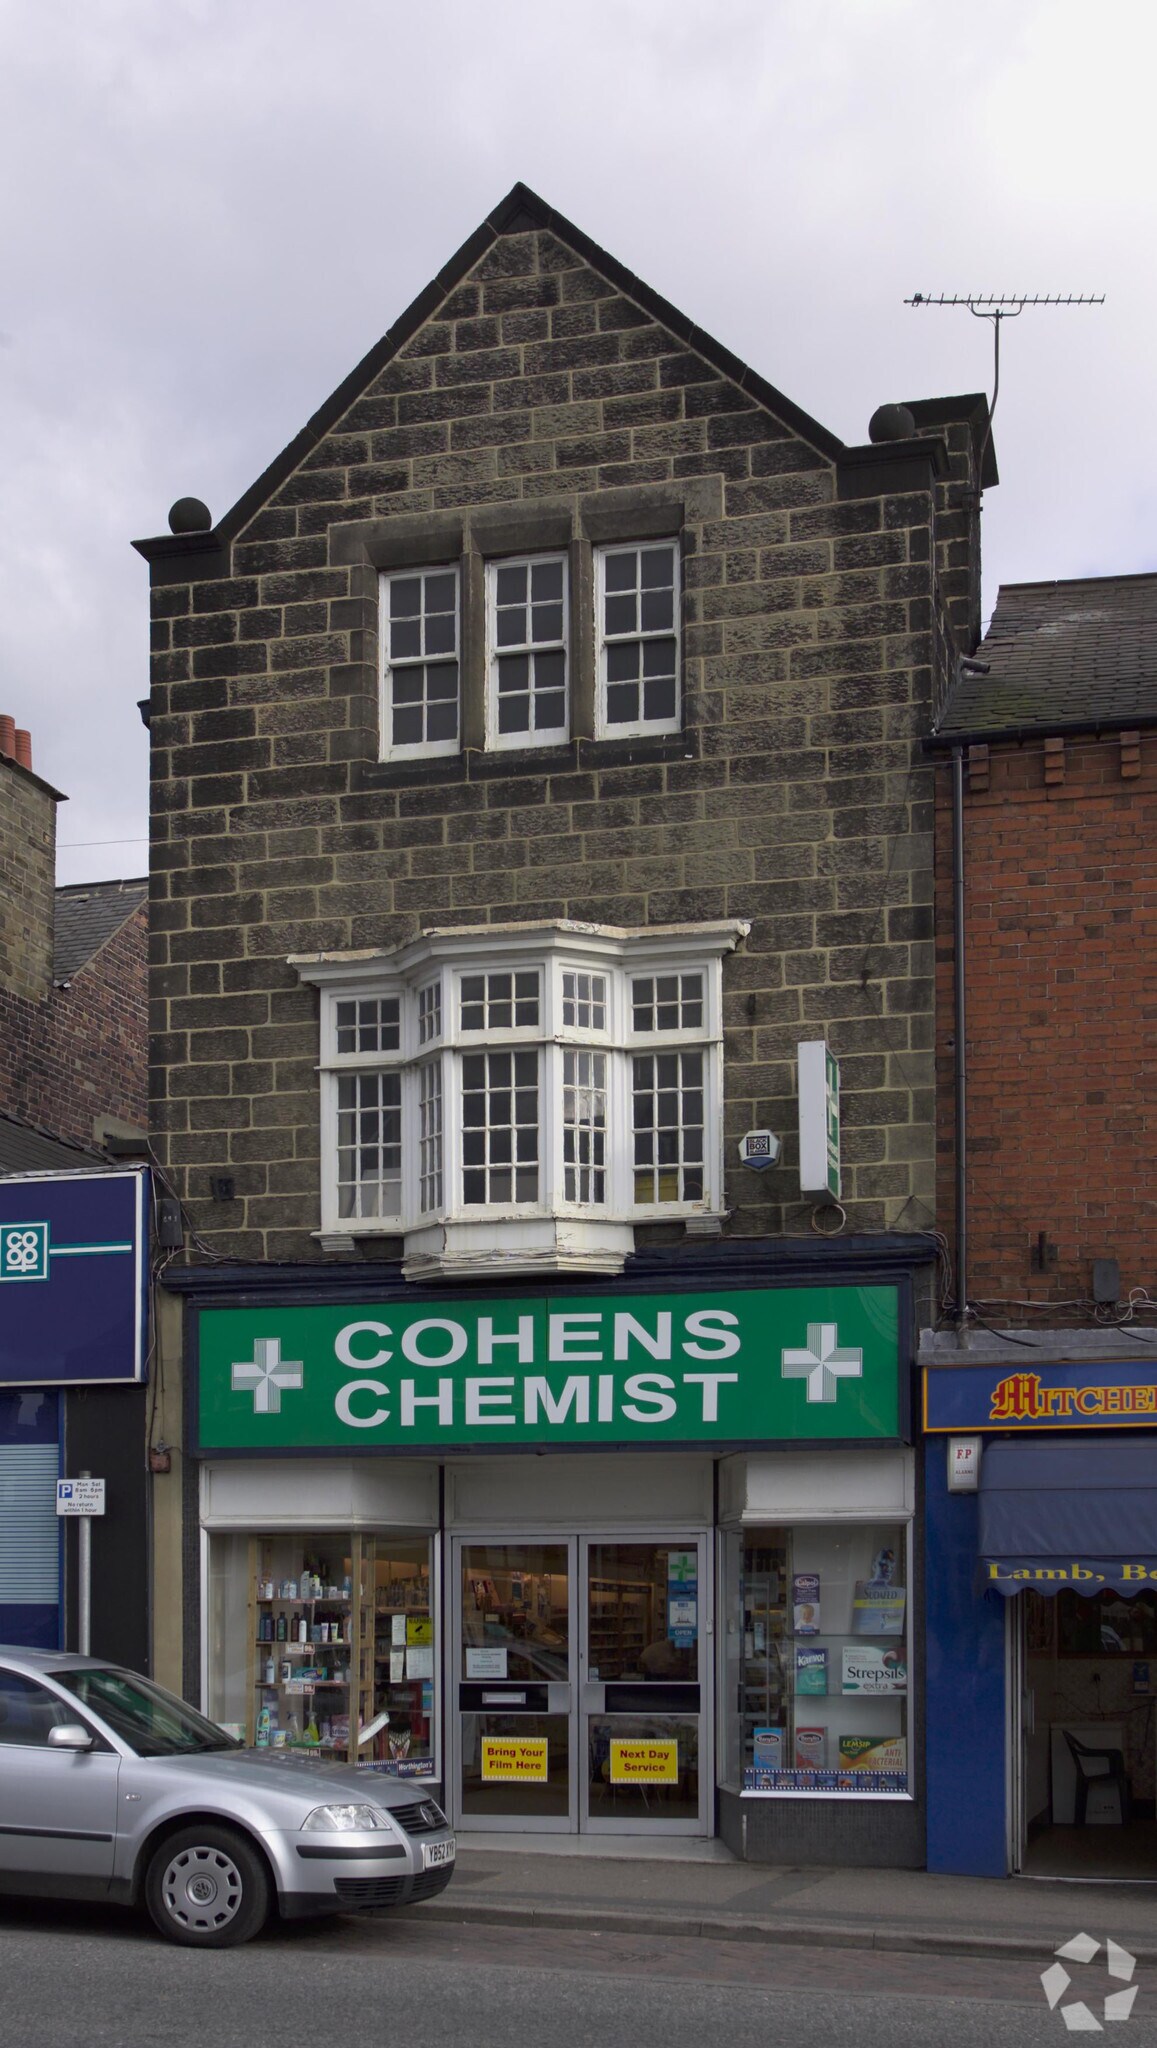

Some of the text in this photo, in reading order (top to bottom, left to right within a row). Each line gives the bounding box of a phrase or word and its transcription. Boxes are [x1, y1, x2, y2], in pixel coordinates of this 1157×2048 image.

[750, 1142, 767, 1150] BOX
[334, 1309, 741, 1369] COHENS
[334, 1372, 739, 1428] CHEMIST
[61, 1485, 72, 1498] P
[987, 1563, 1105, 1583] Lamb,
[847, 1666, 904, 1682] Strepsils
[862, 1682, 889, 1690] extra
[842, 1740, 871, 1748] LEMSIP
[487, 1747, 545, 1758] Bring Your
[620, 1749, 670, 1761] Next Day
[489, 1760, 542, 1770] Film Here
[623, 1762, 666, 1772] Service
[429, 1843, 446, 1863] YB52
